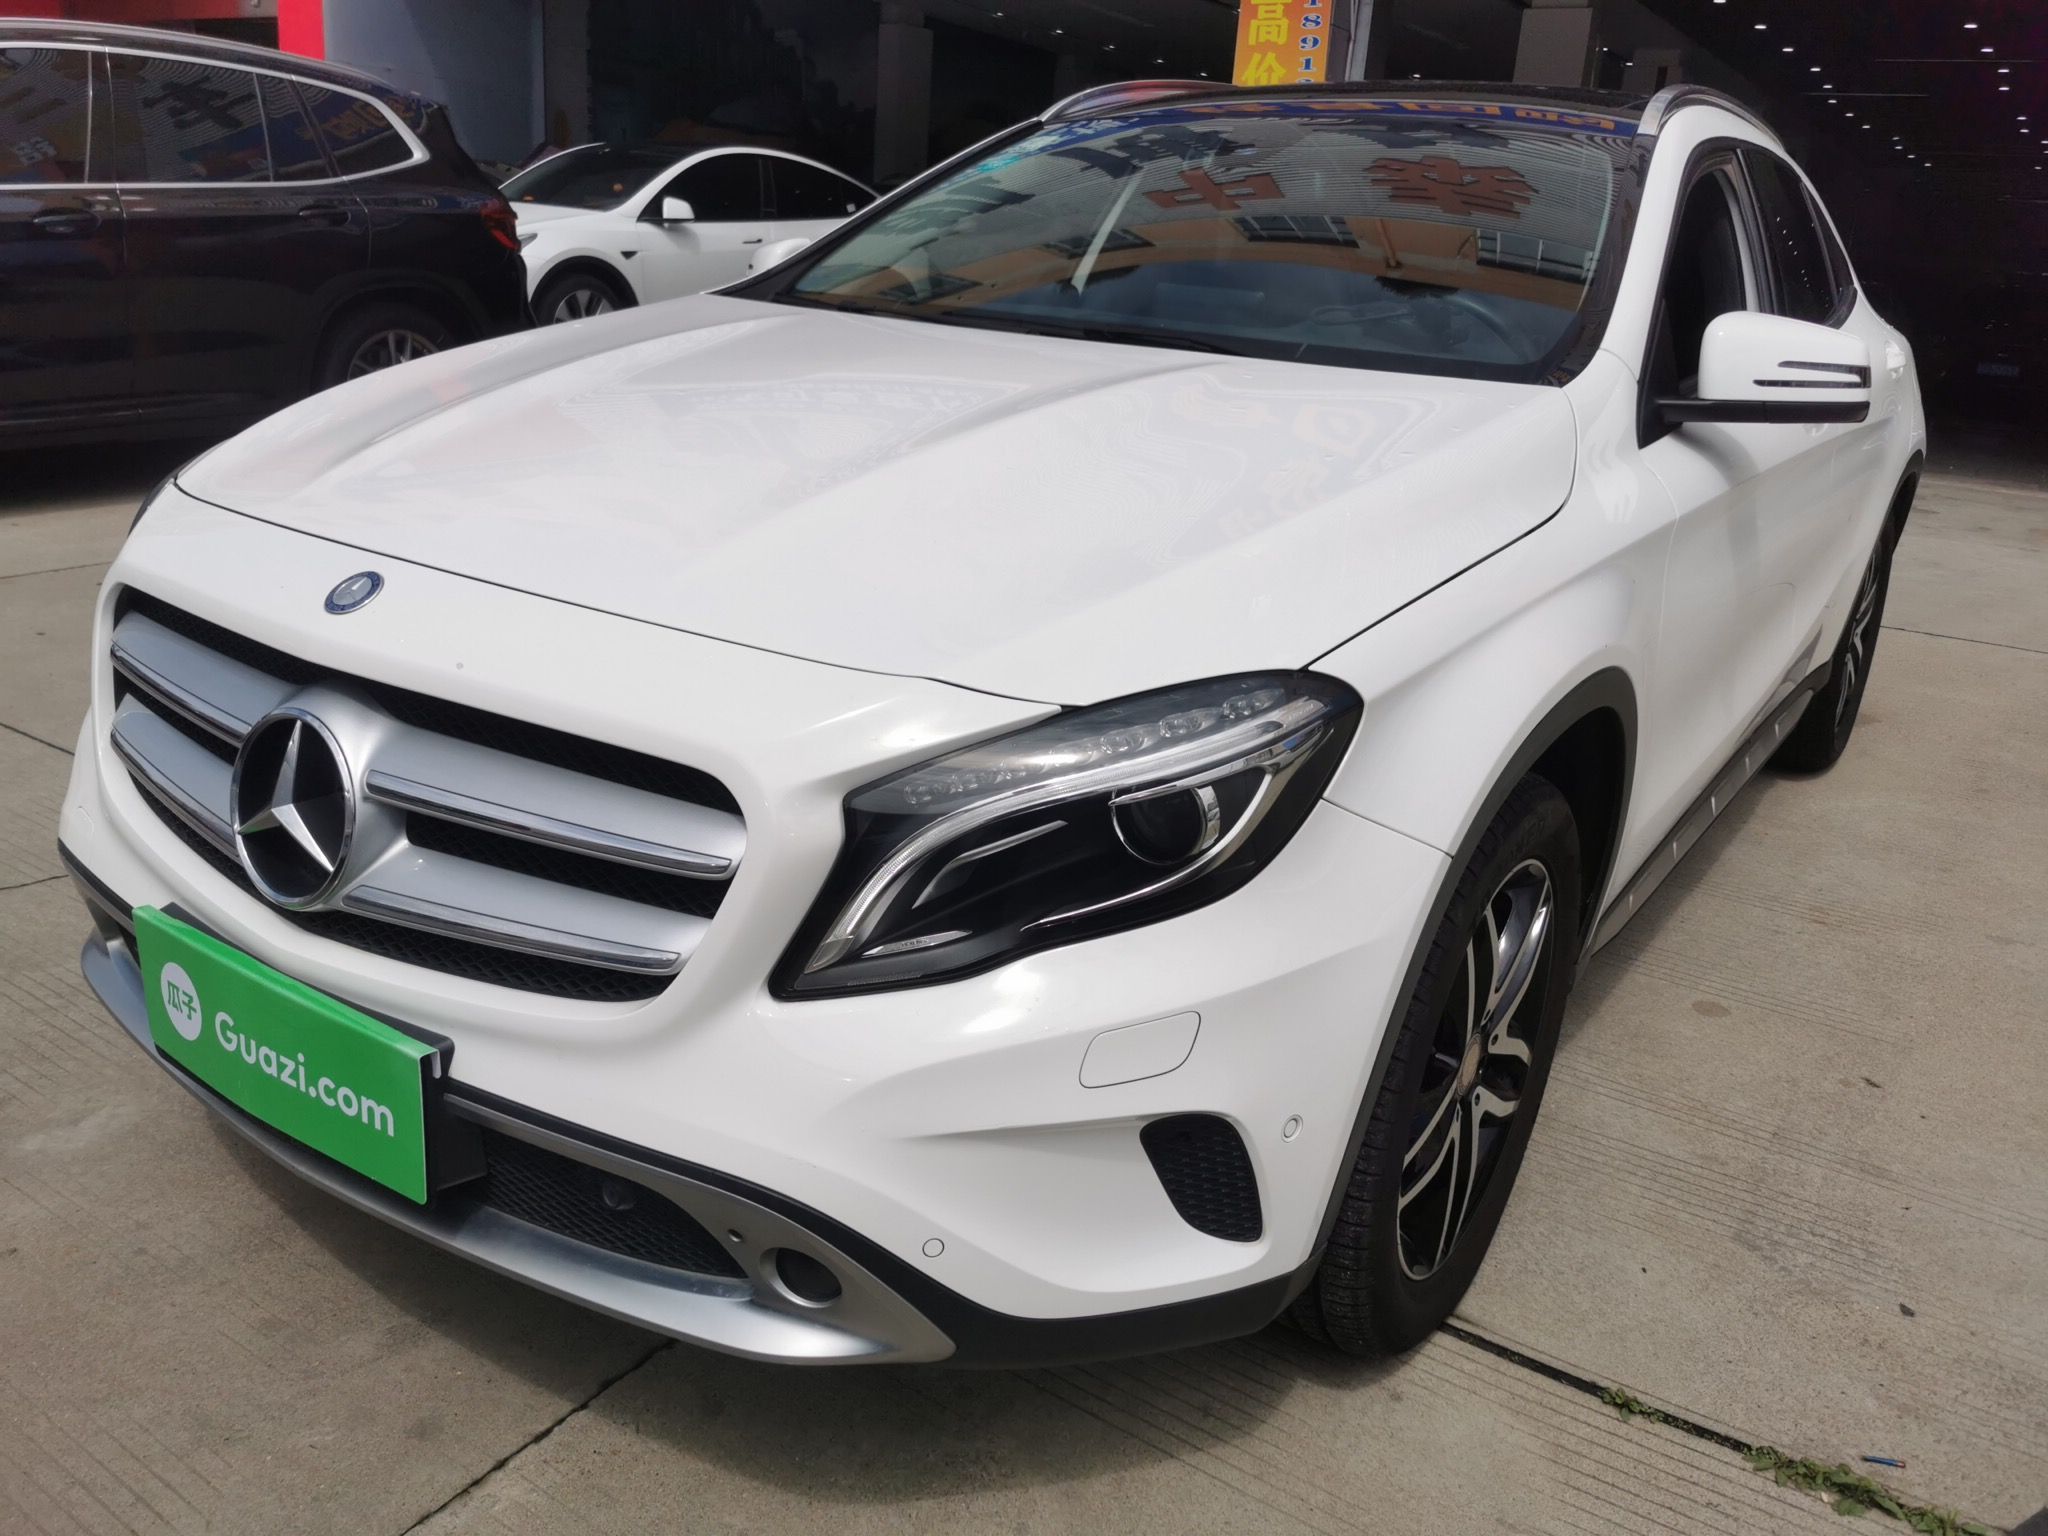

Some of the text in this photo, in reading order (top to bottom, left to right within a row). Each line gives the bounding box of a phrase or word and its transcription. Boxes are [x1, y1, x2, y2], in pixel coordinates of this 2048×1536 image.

[1241, 0, 1292, 87] 高价
[166, 979, 197, 1021] 瓜子
[215, 1011, 395, 1137] Guazi.com
